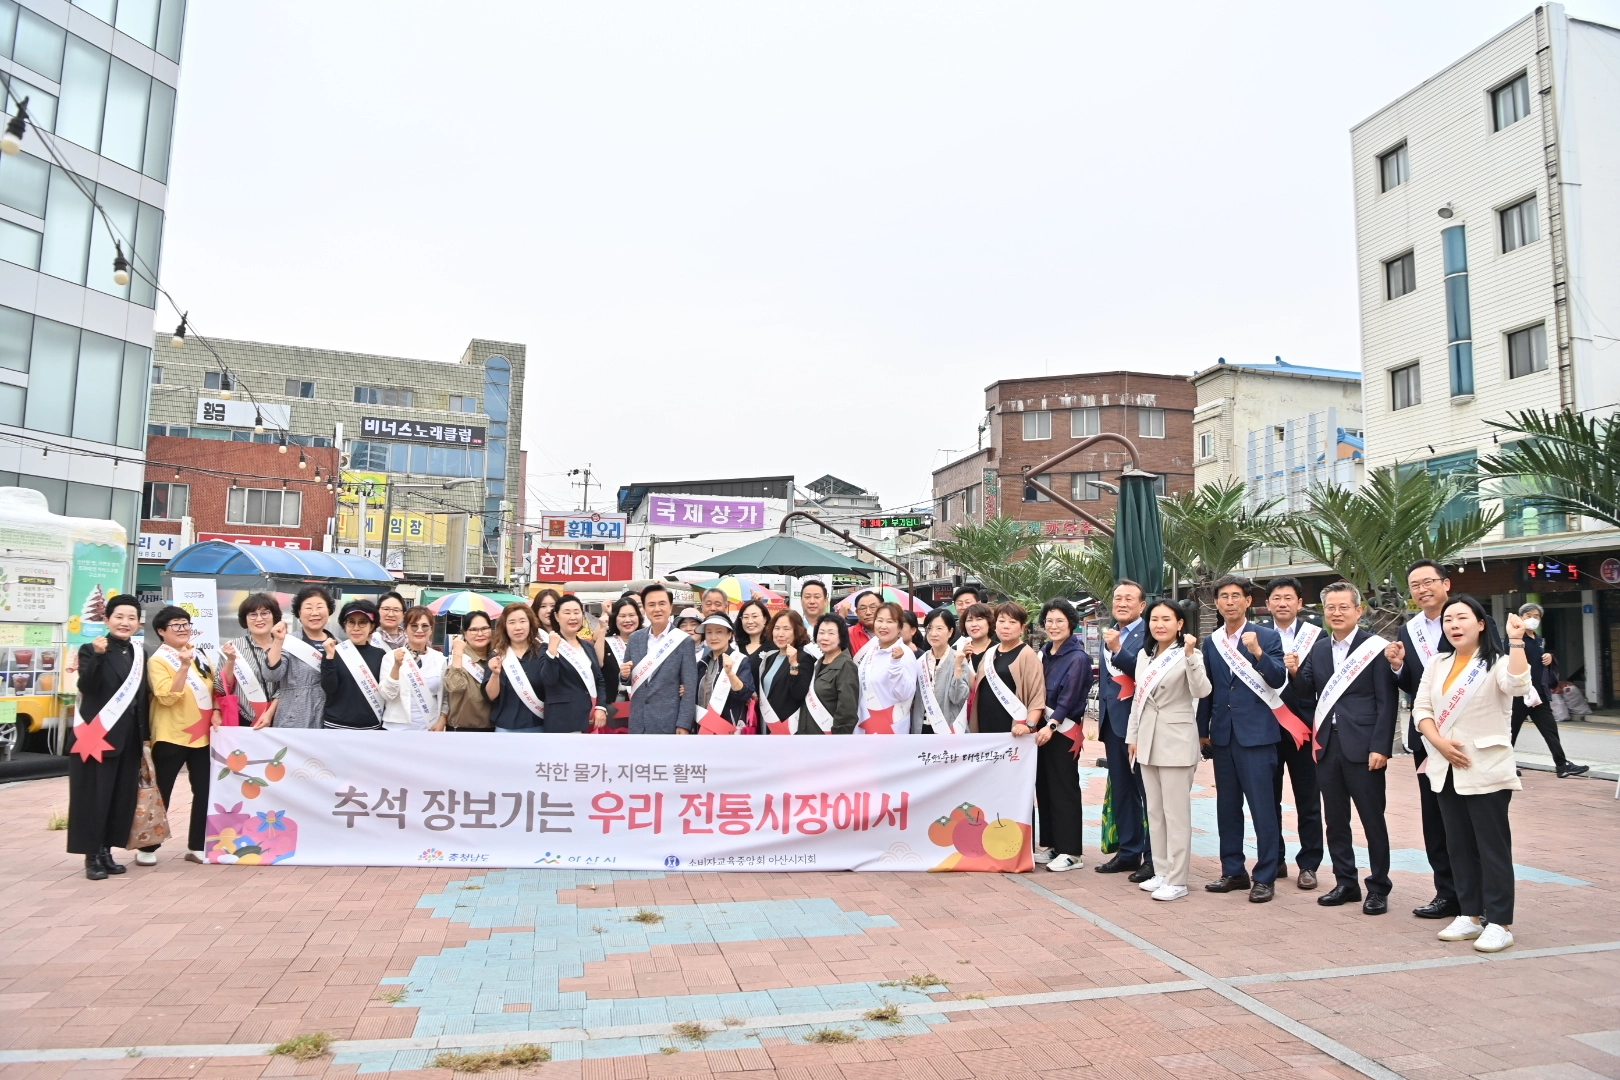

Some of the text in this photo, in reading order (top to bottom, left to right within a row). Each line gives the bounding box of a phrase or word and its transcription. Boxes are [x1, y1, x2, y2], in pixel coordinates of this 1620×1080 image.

[204, 402, 225, 421] 황금
[657, 502, 757, 524] 국제상가
[568, 520, 620, 539] 훈제 오리
[870, 519, 888, 527] 3배가
[539, 552, 607, 576] 훈제오리
[639, 661, 653, 676] 우리가
[1345, 650, 1374, 681] 전통시장에서
[1144, 670, 1157, 689] 우리가
[1235, 665, 1266, 694] 전통시장에서
[1464, 669, 1478, 686] 물가,
[1448, 687, 1465, 711] 우리가
[1005, 747, 1020, 762] 힘
[535, 762, 708, 783] 착한 물가, 지역도 활짝
[332, 786, 910, 835] 추석 장보기는 우리 전통시장에서
[448, 853, 489, 863] 충청남도
[568, 855, 616, 865] 아산시
[688, 854, 817, 867] 소비자교육중앙회 아산시지회
